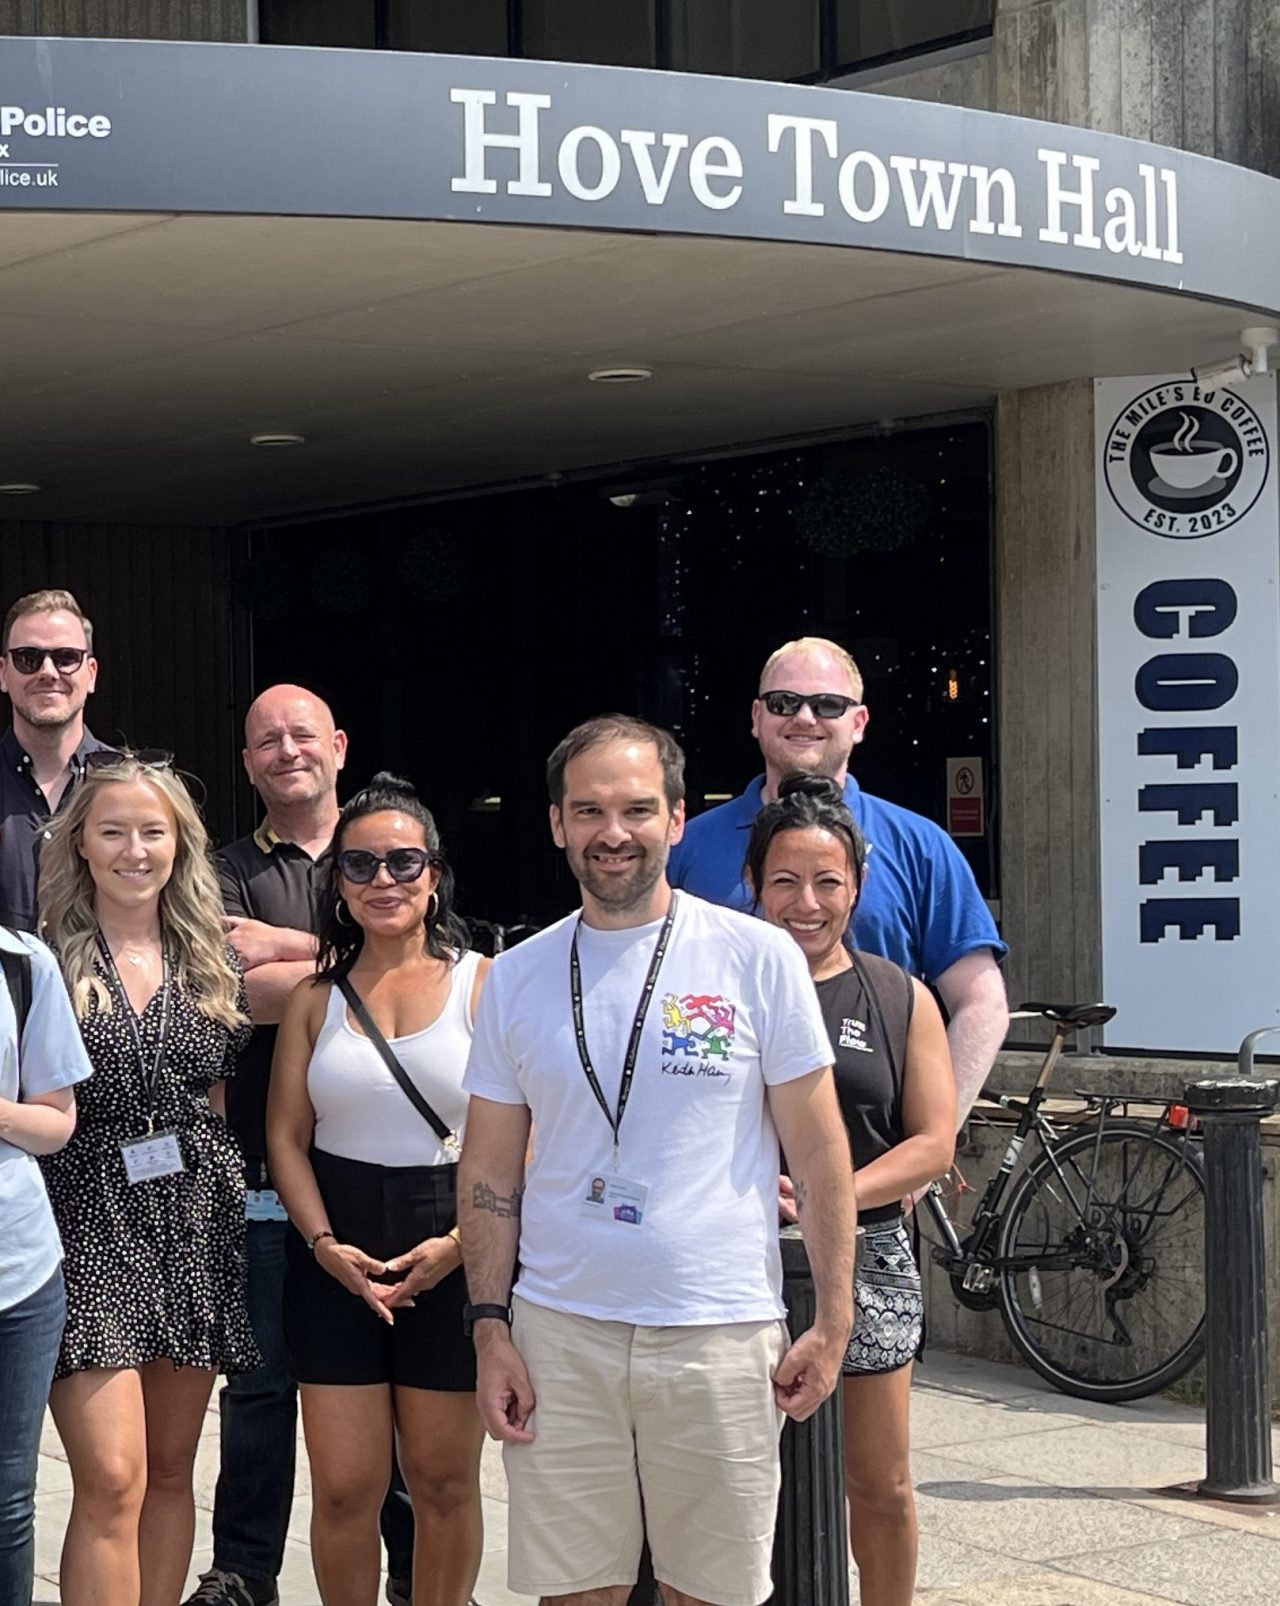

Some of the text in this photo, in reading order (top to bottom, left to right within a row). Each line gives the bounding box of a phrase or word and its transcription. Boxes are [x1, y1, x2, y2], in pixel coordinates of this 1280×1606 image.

[0, 105, 112, 138] Police
[450, 87, 1184, 265] Hove Town Hall
[1109, 429, 1131, 463] THE
[1125, 387, 1184, 427] MILE'S
[1220, 397, 1265, 457] COFFEE
[1143, 503, 1237, 533] EST. 2023
[1133, 578, 1241, 943] COFFEE
